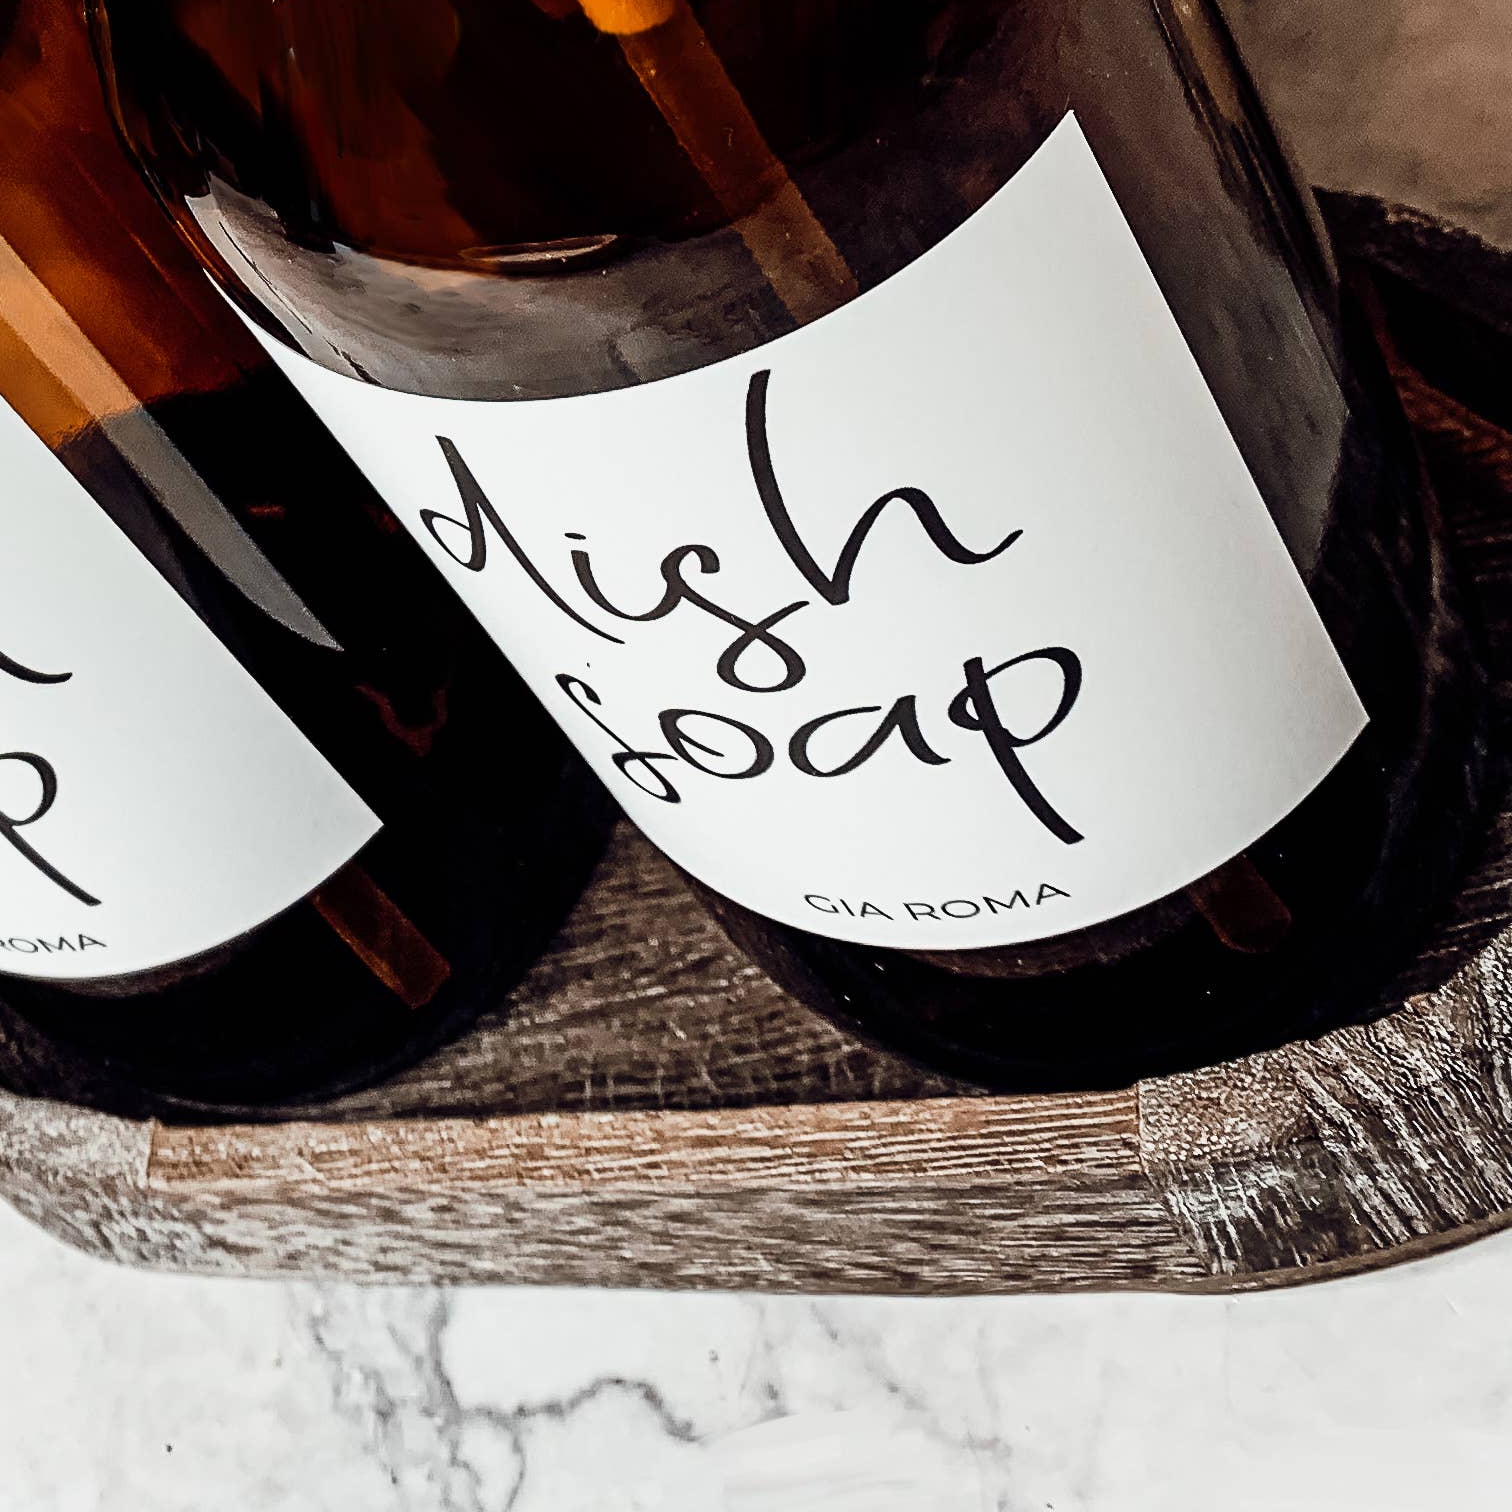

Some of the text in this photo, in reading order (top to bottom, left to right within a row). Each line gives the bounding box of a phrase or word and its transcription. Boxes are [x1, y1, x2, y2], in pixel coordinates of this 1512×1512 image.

[419, 368, 1024, 692] dish
[554, 645, 1085, 845] soap
[803, 882, 1072, 921] GIA ROMA
